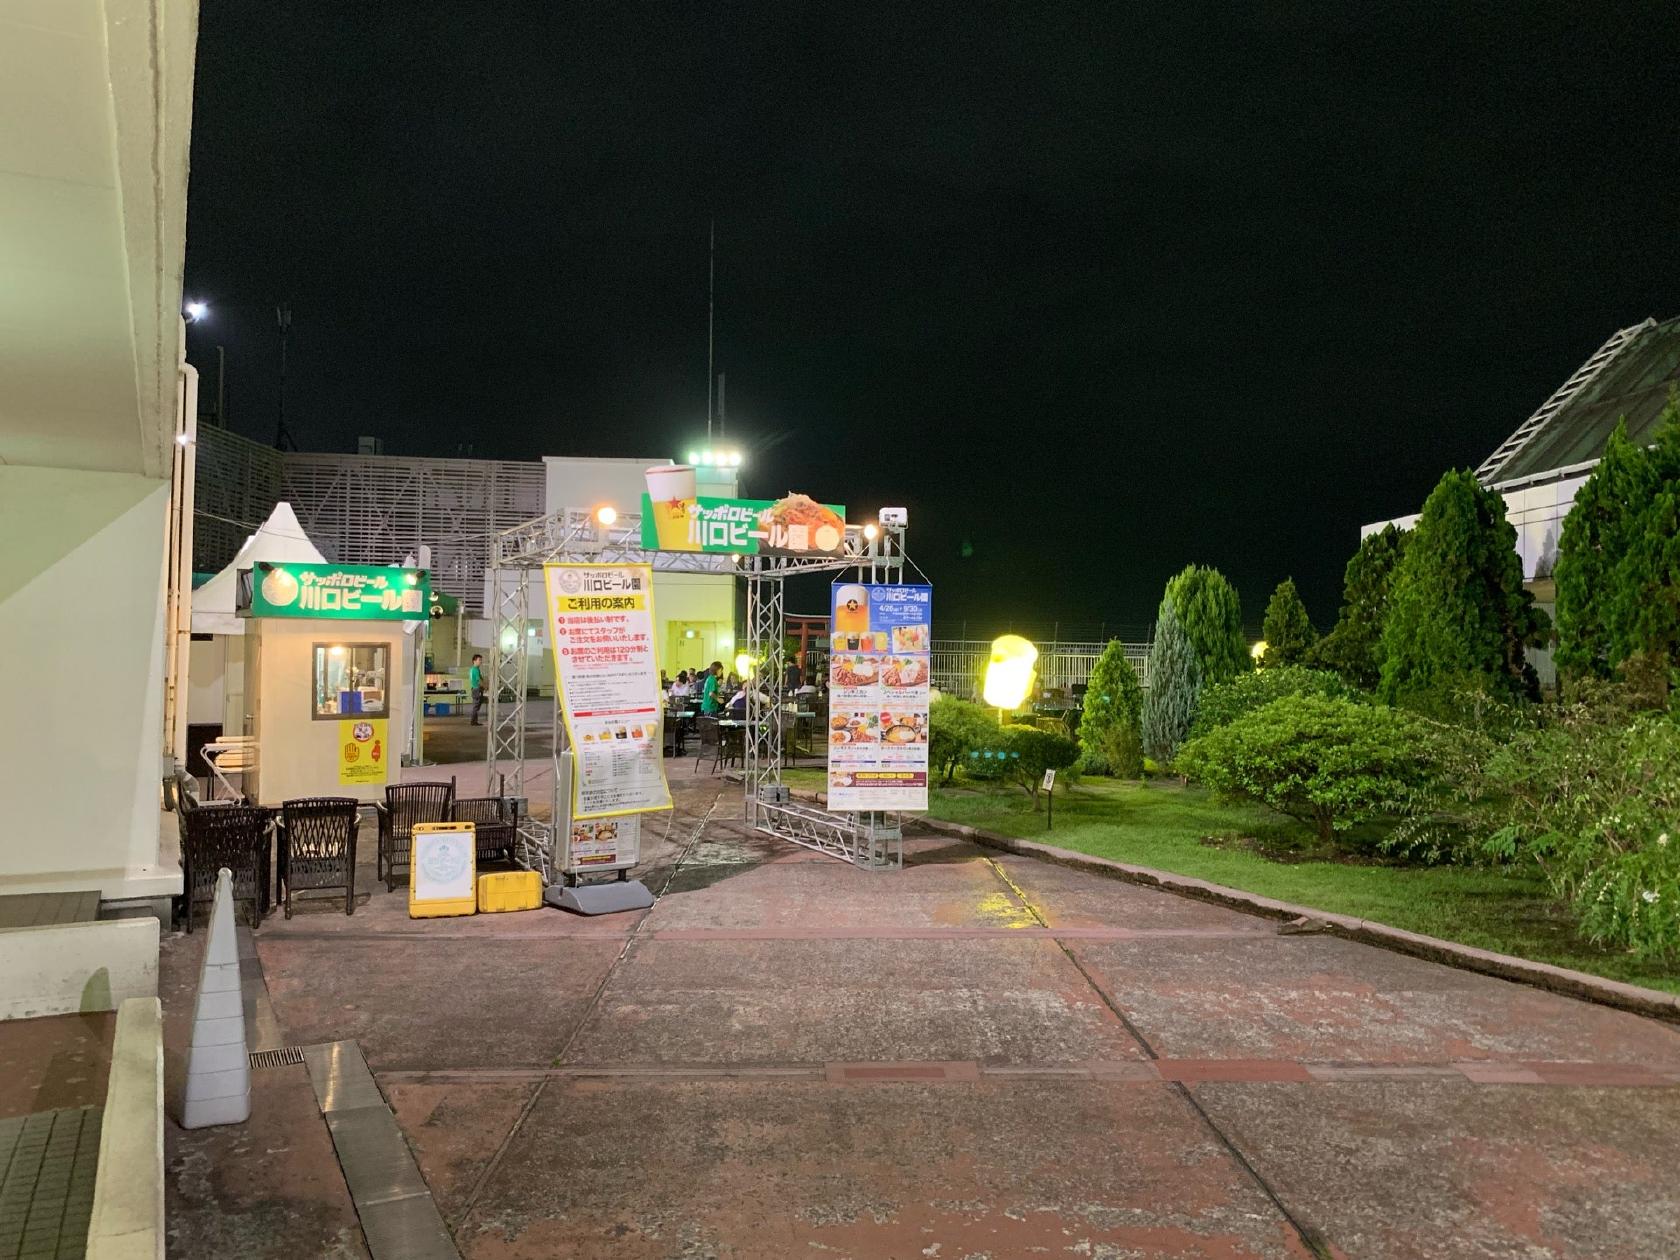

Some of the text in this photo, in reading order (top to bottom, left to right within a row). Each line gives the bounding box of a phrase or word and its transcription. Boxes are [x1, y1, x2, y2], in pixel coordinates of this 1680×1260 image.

[688, 504, 774, 523] サッポロビール
[688, 520, 808, 550] 川口ビール園
[300, 571, 388, 589] サッポロビール
[584, 571, 624, 579] サッポロビール
[583, 578, 641, 592] 川口ビール園
[299, 586, 423, 613] 川口ビール園
[568, 597, 635, 610] ご利用の案内
